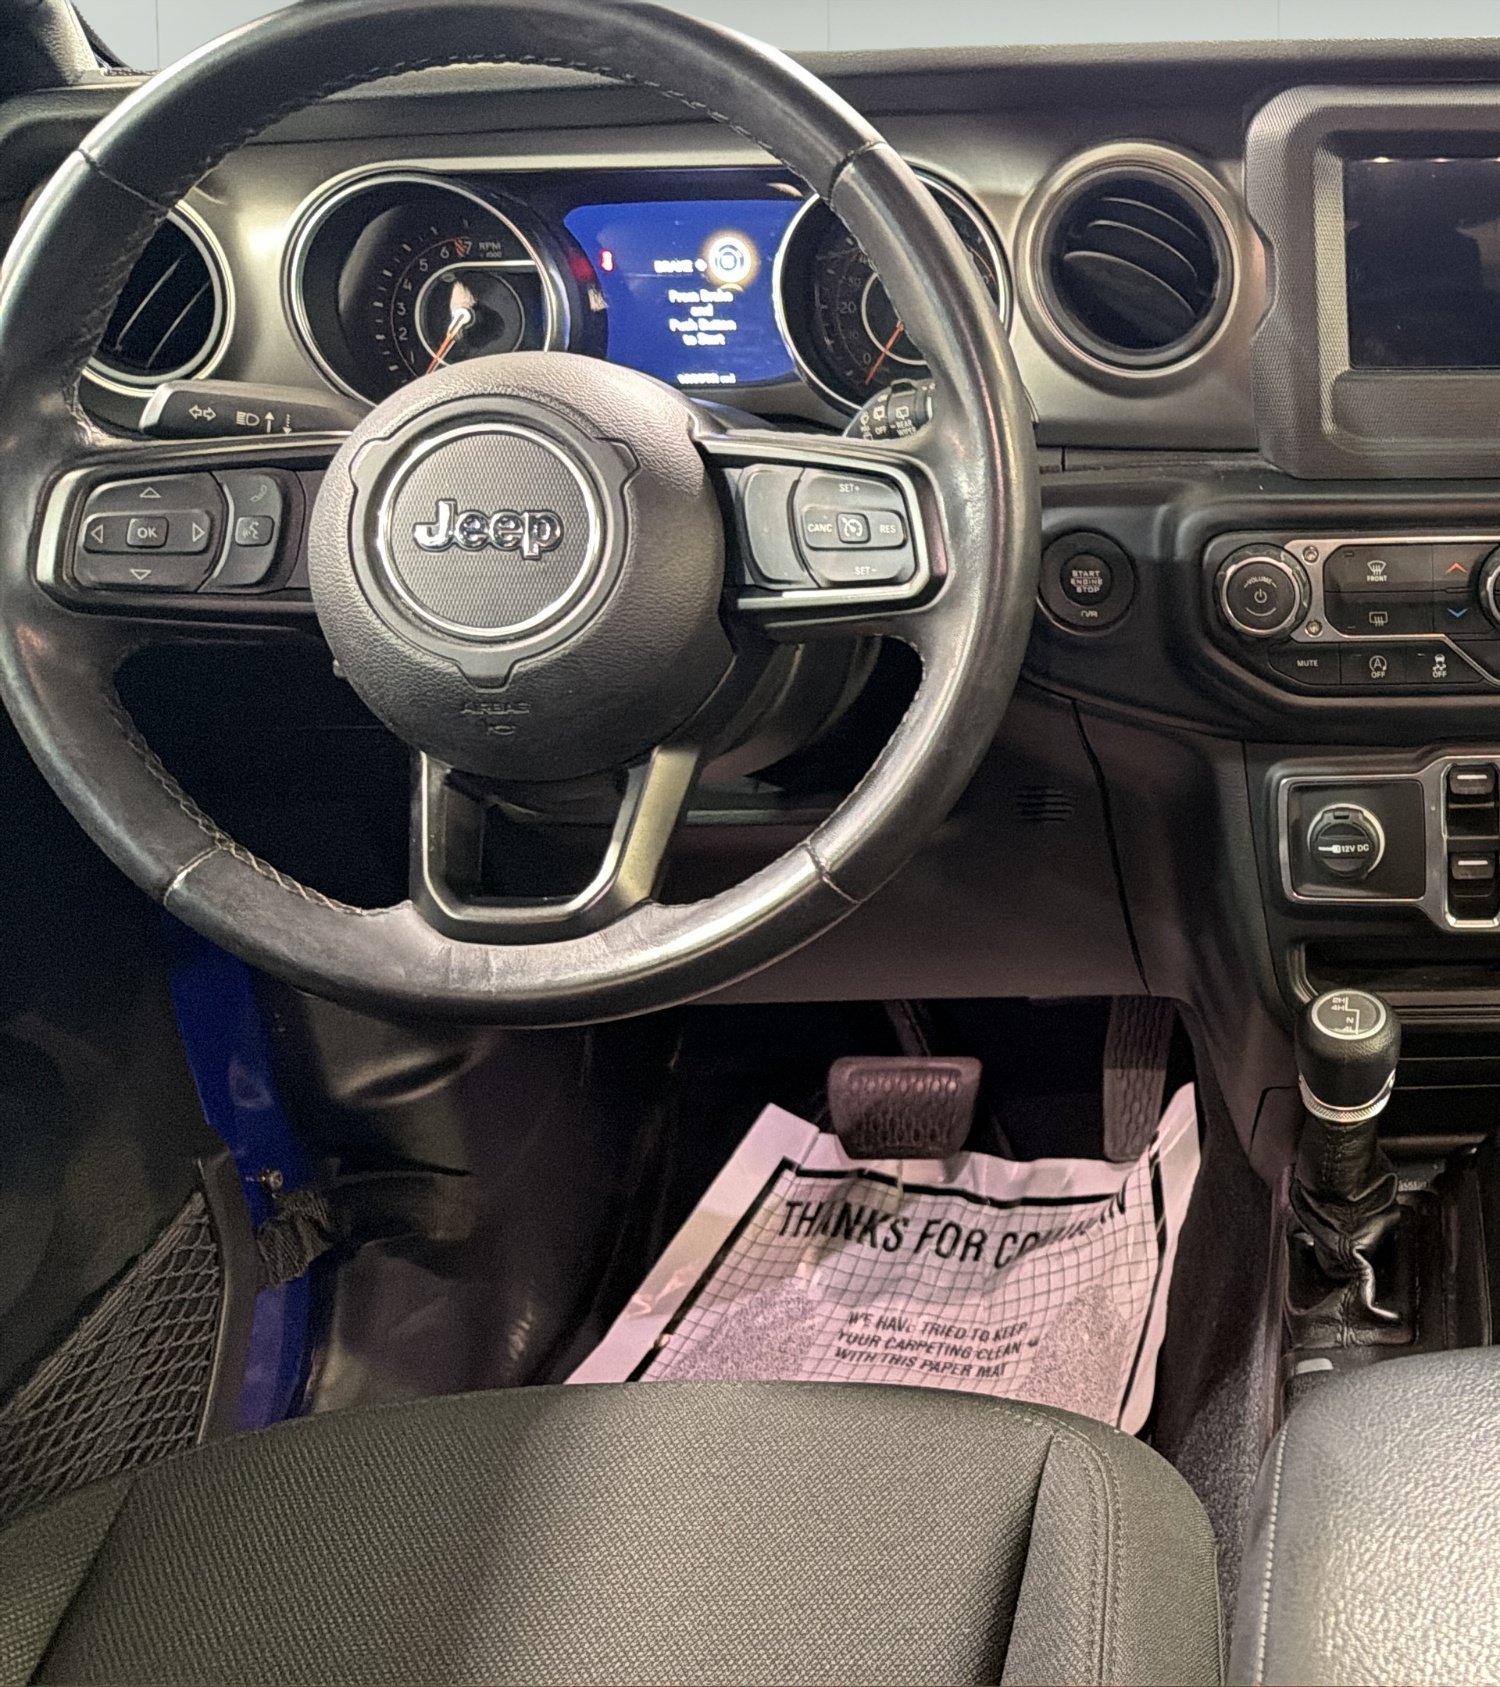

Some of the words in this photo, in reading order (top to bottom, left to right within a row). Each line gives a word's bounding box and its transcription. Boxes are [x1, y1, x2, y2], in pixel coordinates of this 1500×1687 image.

[440, 246, 449, 258] 6
[419, 259, 429, 271] 5
[403, 280, 412, 291] 4
[397, 302, 406, 316] 3
[398, 327, 408, 340] 2
[137, 527, 158, 538] OK
[412, 498, 565, 560] Jeep
[808, 523, 833, 533] CANC
[879, 525, 896, 534] RES
[1247, 576, 1273, 585] VOLUME
[1341, 845, 1355, 853] 12V
[1357, 844, 1369, 852] DC
[779, 1201, 909, 1252] THANKS
[914, 1218, 988, 1262] FOR
[849, 1311, 873, 1326] WE
[921, 1321, 966, 1340] TRIED
[970, 1328, 990, 1341] TO
[993, 1322, 1028, 1342] KEEP
[838, 1328, 882, 1347] YOUR
[884, 1337, 973, 1359] CARPETING
[976, 1340, 1022, 1360] CLEAN
[835, 1346, 877, 1362] WITH
[879, 1350, 918, 1367] THIS
[919, 1360, 974, 1377] PAPER
